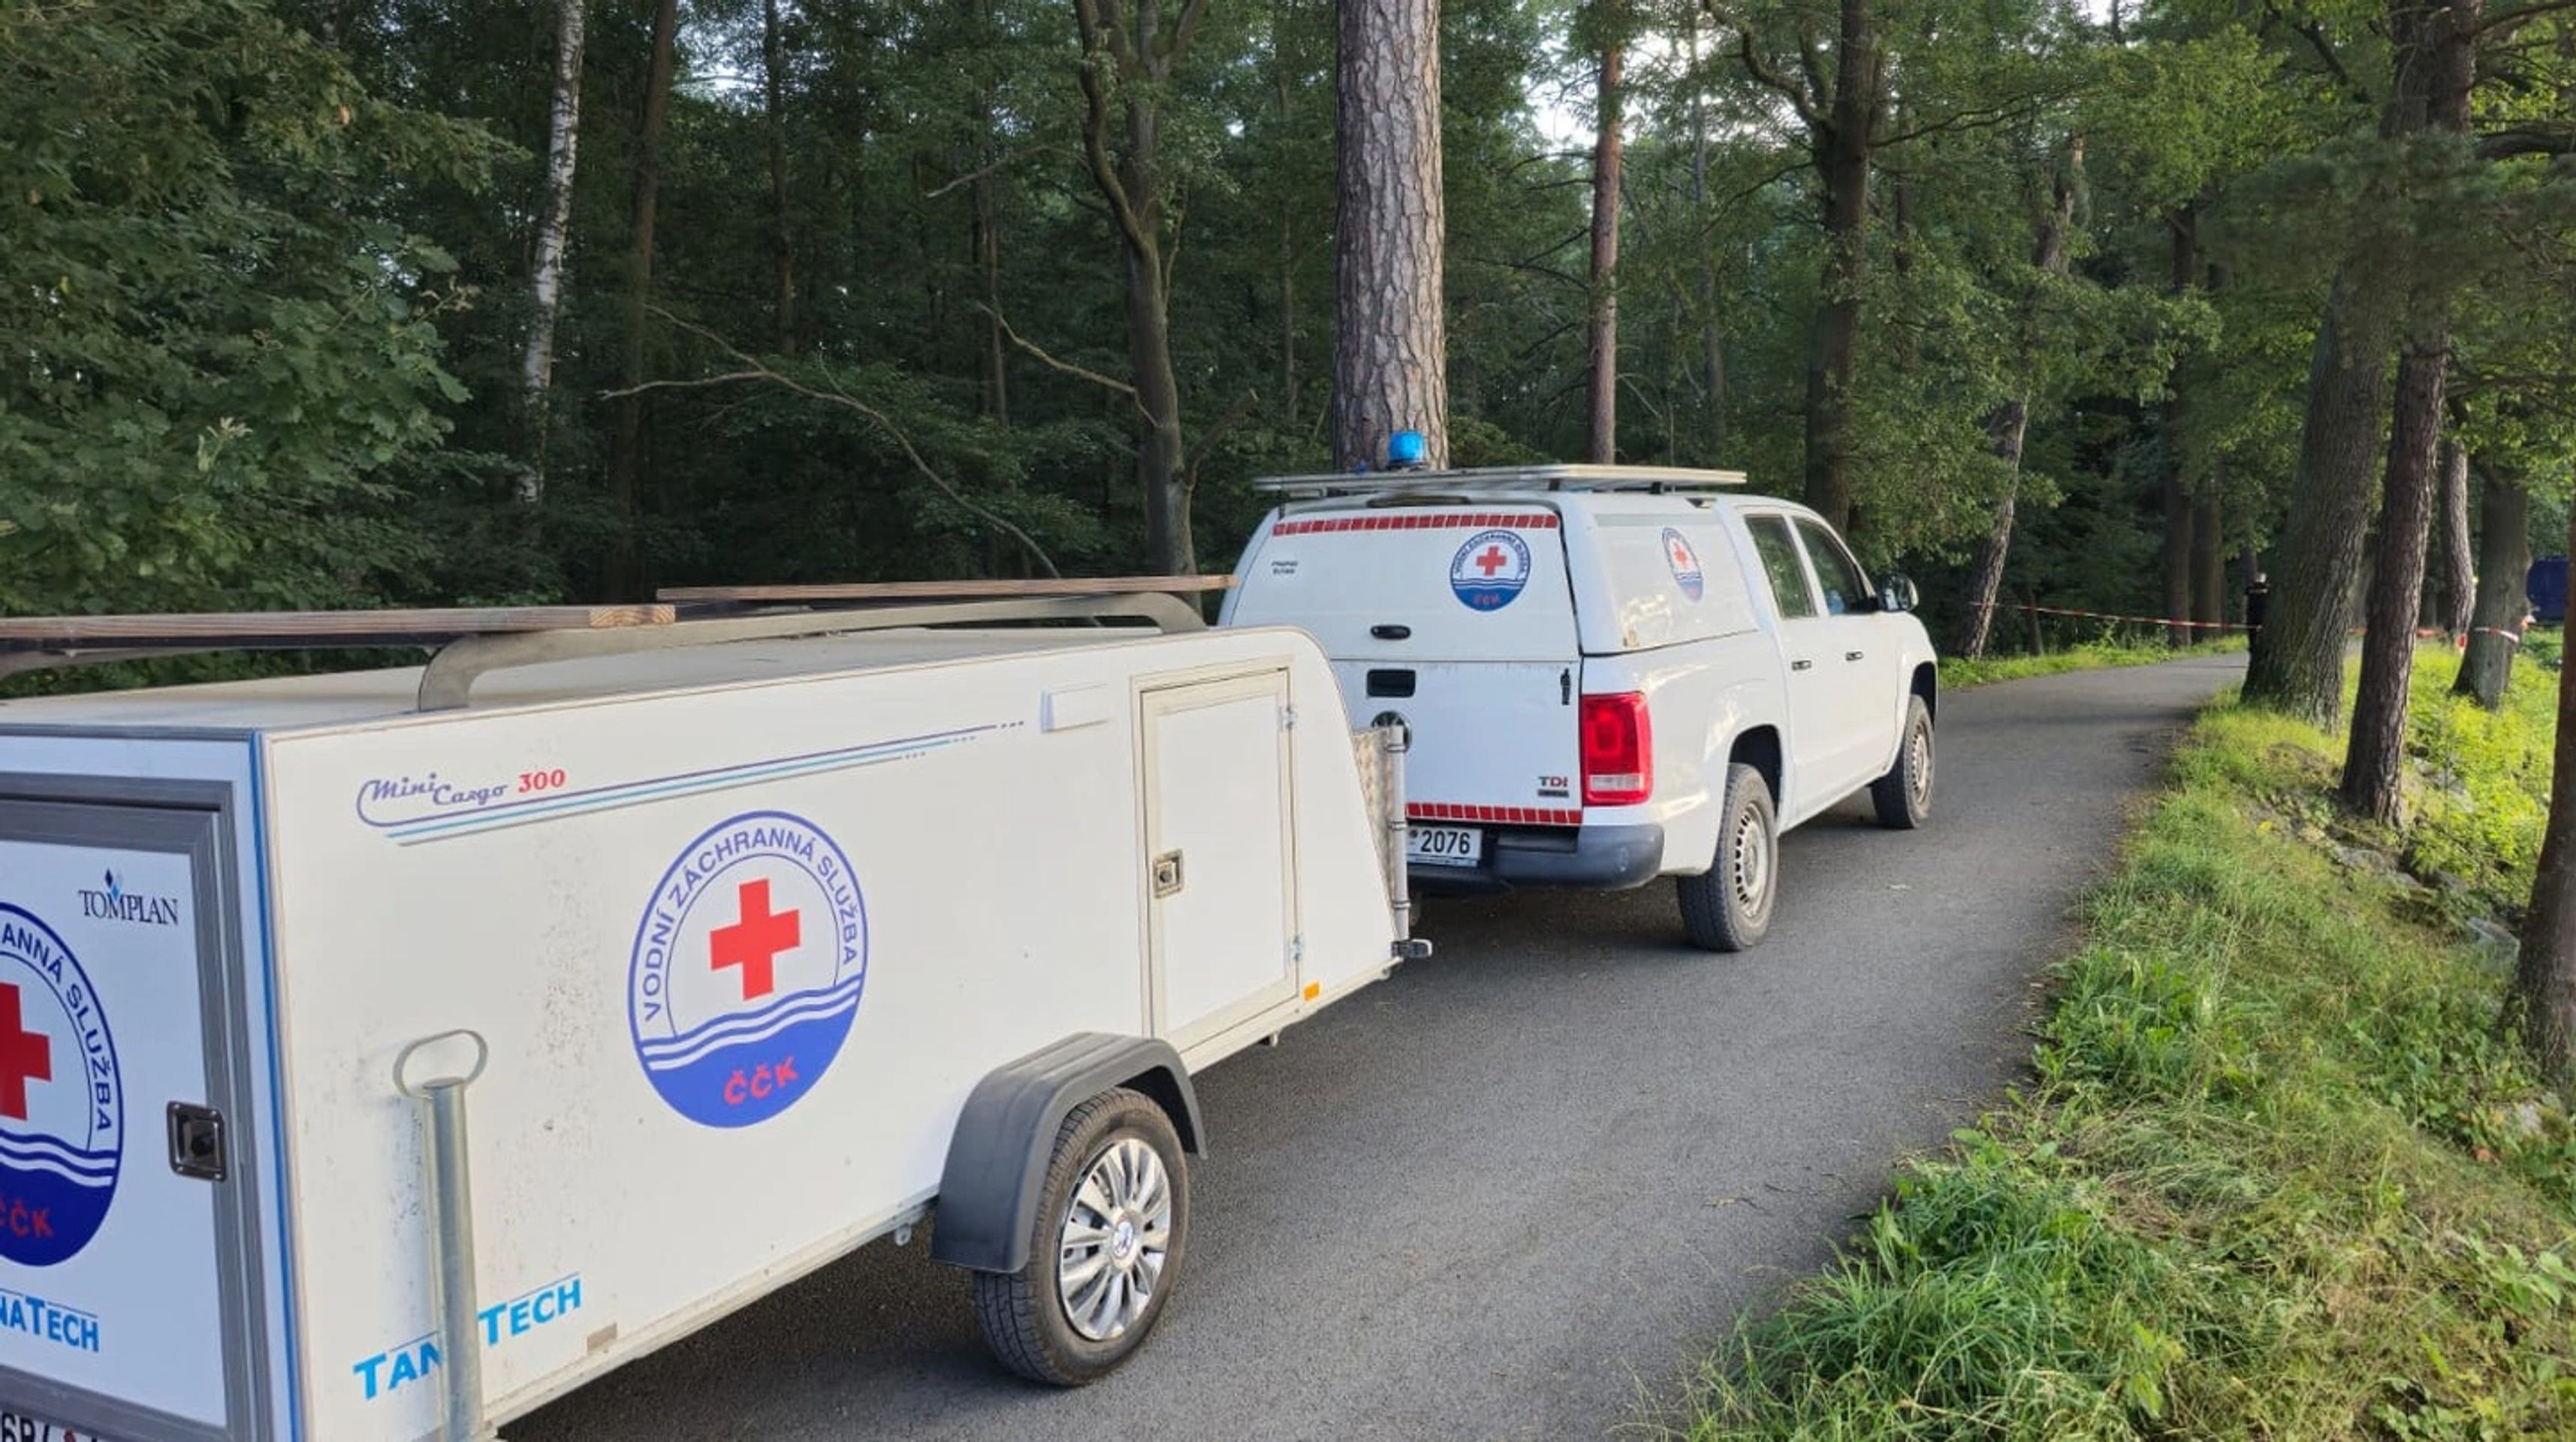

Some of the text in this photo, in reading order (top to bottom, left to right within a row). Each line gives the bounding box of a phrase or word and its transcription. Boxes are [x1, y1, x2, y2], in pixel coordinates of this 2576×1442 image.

[517, 768, 566, 794] 300
[1537, 776, 1568, 788] TDI
[1419, 829, 1470, 855] 2076
[78, 889, 179, 926] TOMPLAN
[642, 826, 859, 1022] VODNÍ ZÁCHRANNÁ SLUŽBA
[66, 982, 113, 1130] SLUŽBA
[724, 1055, 799, 1106] ČČK
[352, 1278, 581, 1401] TANTECH
